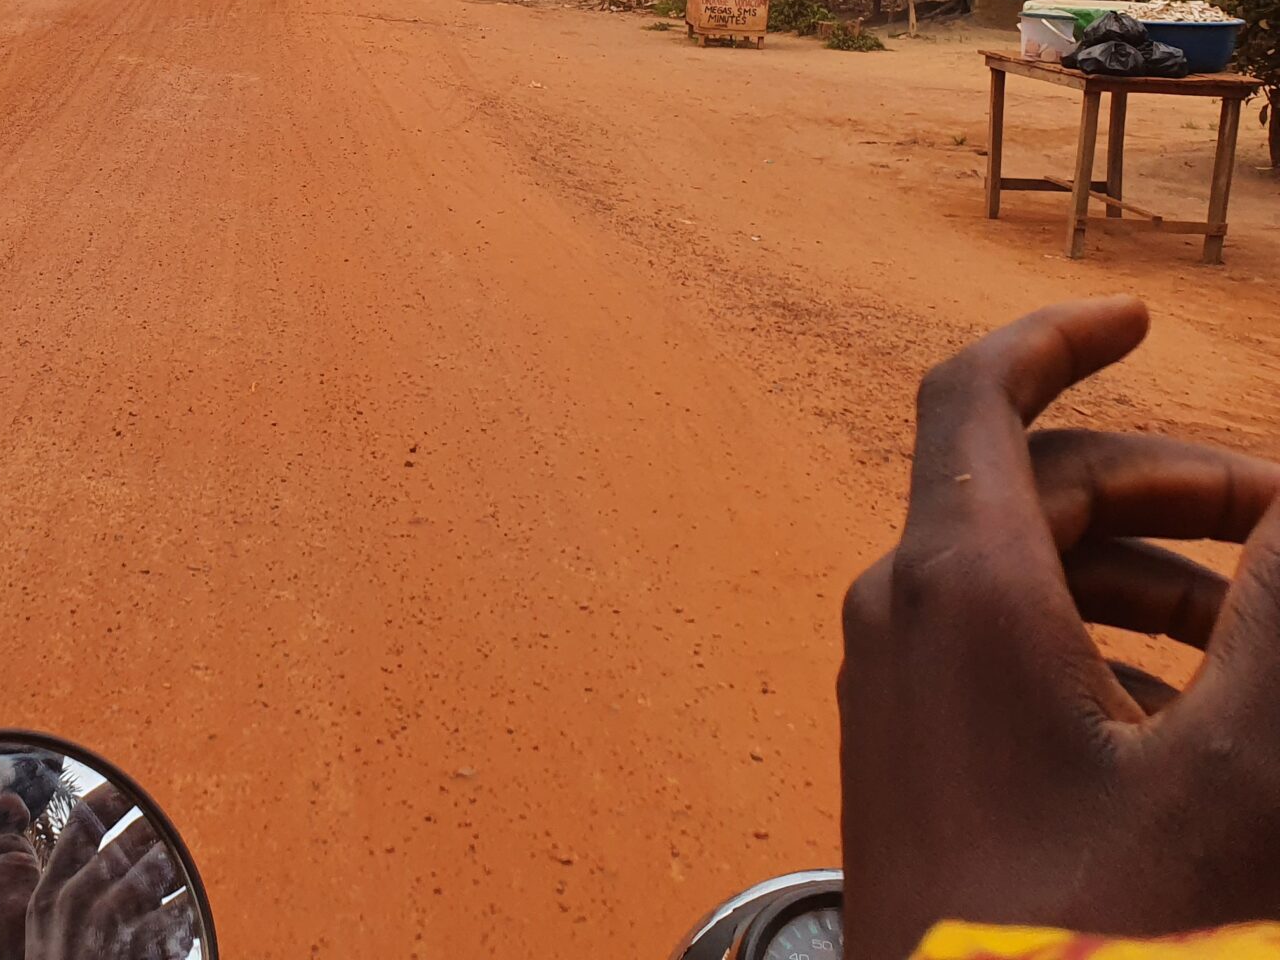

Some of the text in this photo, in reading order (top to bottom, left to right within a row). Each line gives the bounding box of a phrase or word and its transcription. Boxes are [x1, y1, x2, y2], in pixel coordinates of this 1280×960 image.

[737, 8, 757, 17] SMS
[708, 14, 747, 25] MINUTES
[811, 939, 833, 951] 50
